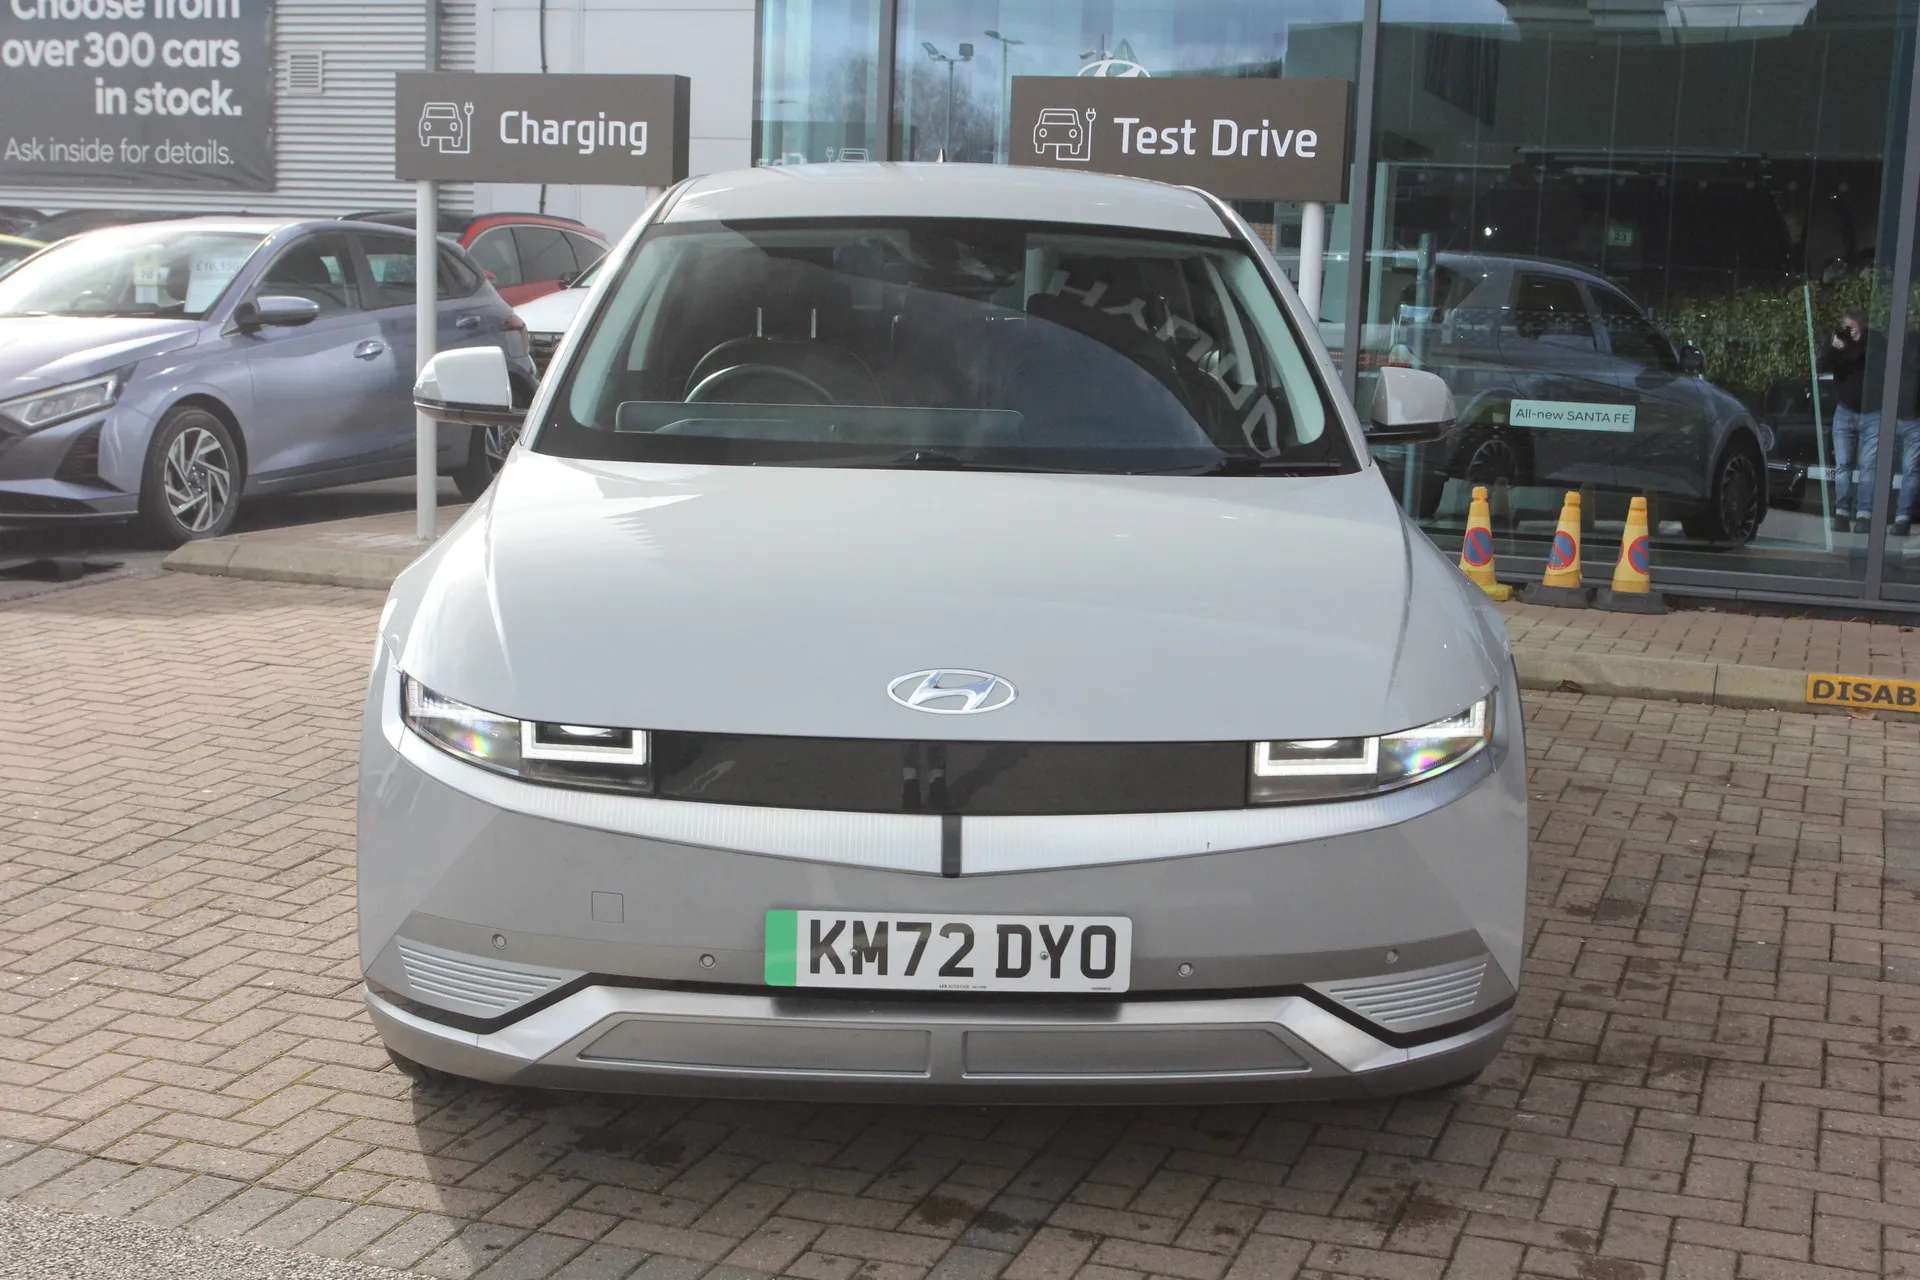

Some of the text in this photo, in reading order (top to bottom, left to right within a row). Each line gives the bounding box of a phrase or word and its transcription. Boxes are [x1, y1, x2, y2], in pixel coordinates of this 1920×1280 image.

[2, 32, 241, 68] over 300 cars
[95, 77, 243, 116] in stock.
[4, 137, 235, 165] Ask inside for details.
[500, 110, 648, 156] Charging
[1113, 117, 1318, 158] Test Drive
[1515, 407, 1630, 424] All-new SANTA FE
[809, 919, 1117, 980] KM72 DYO
